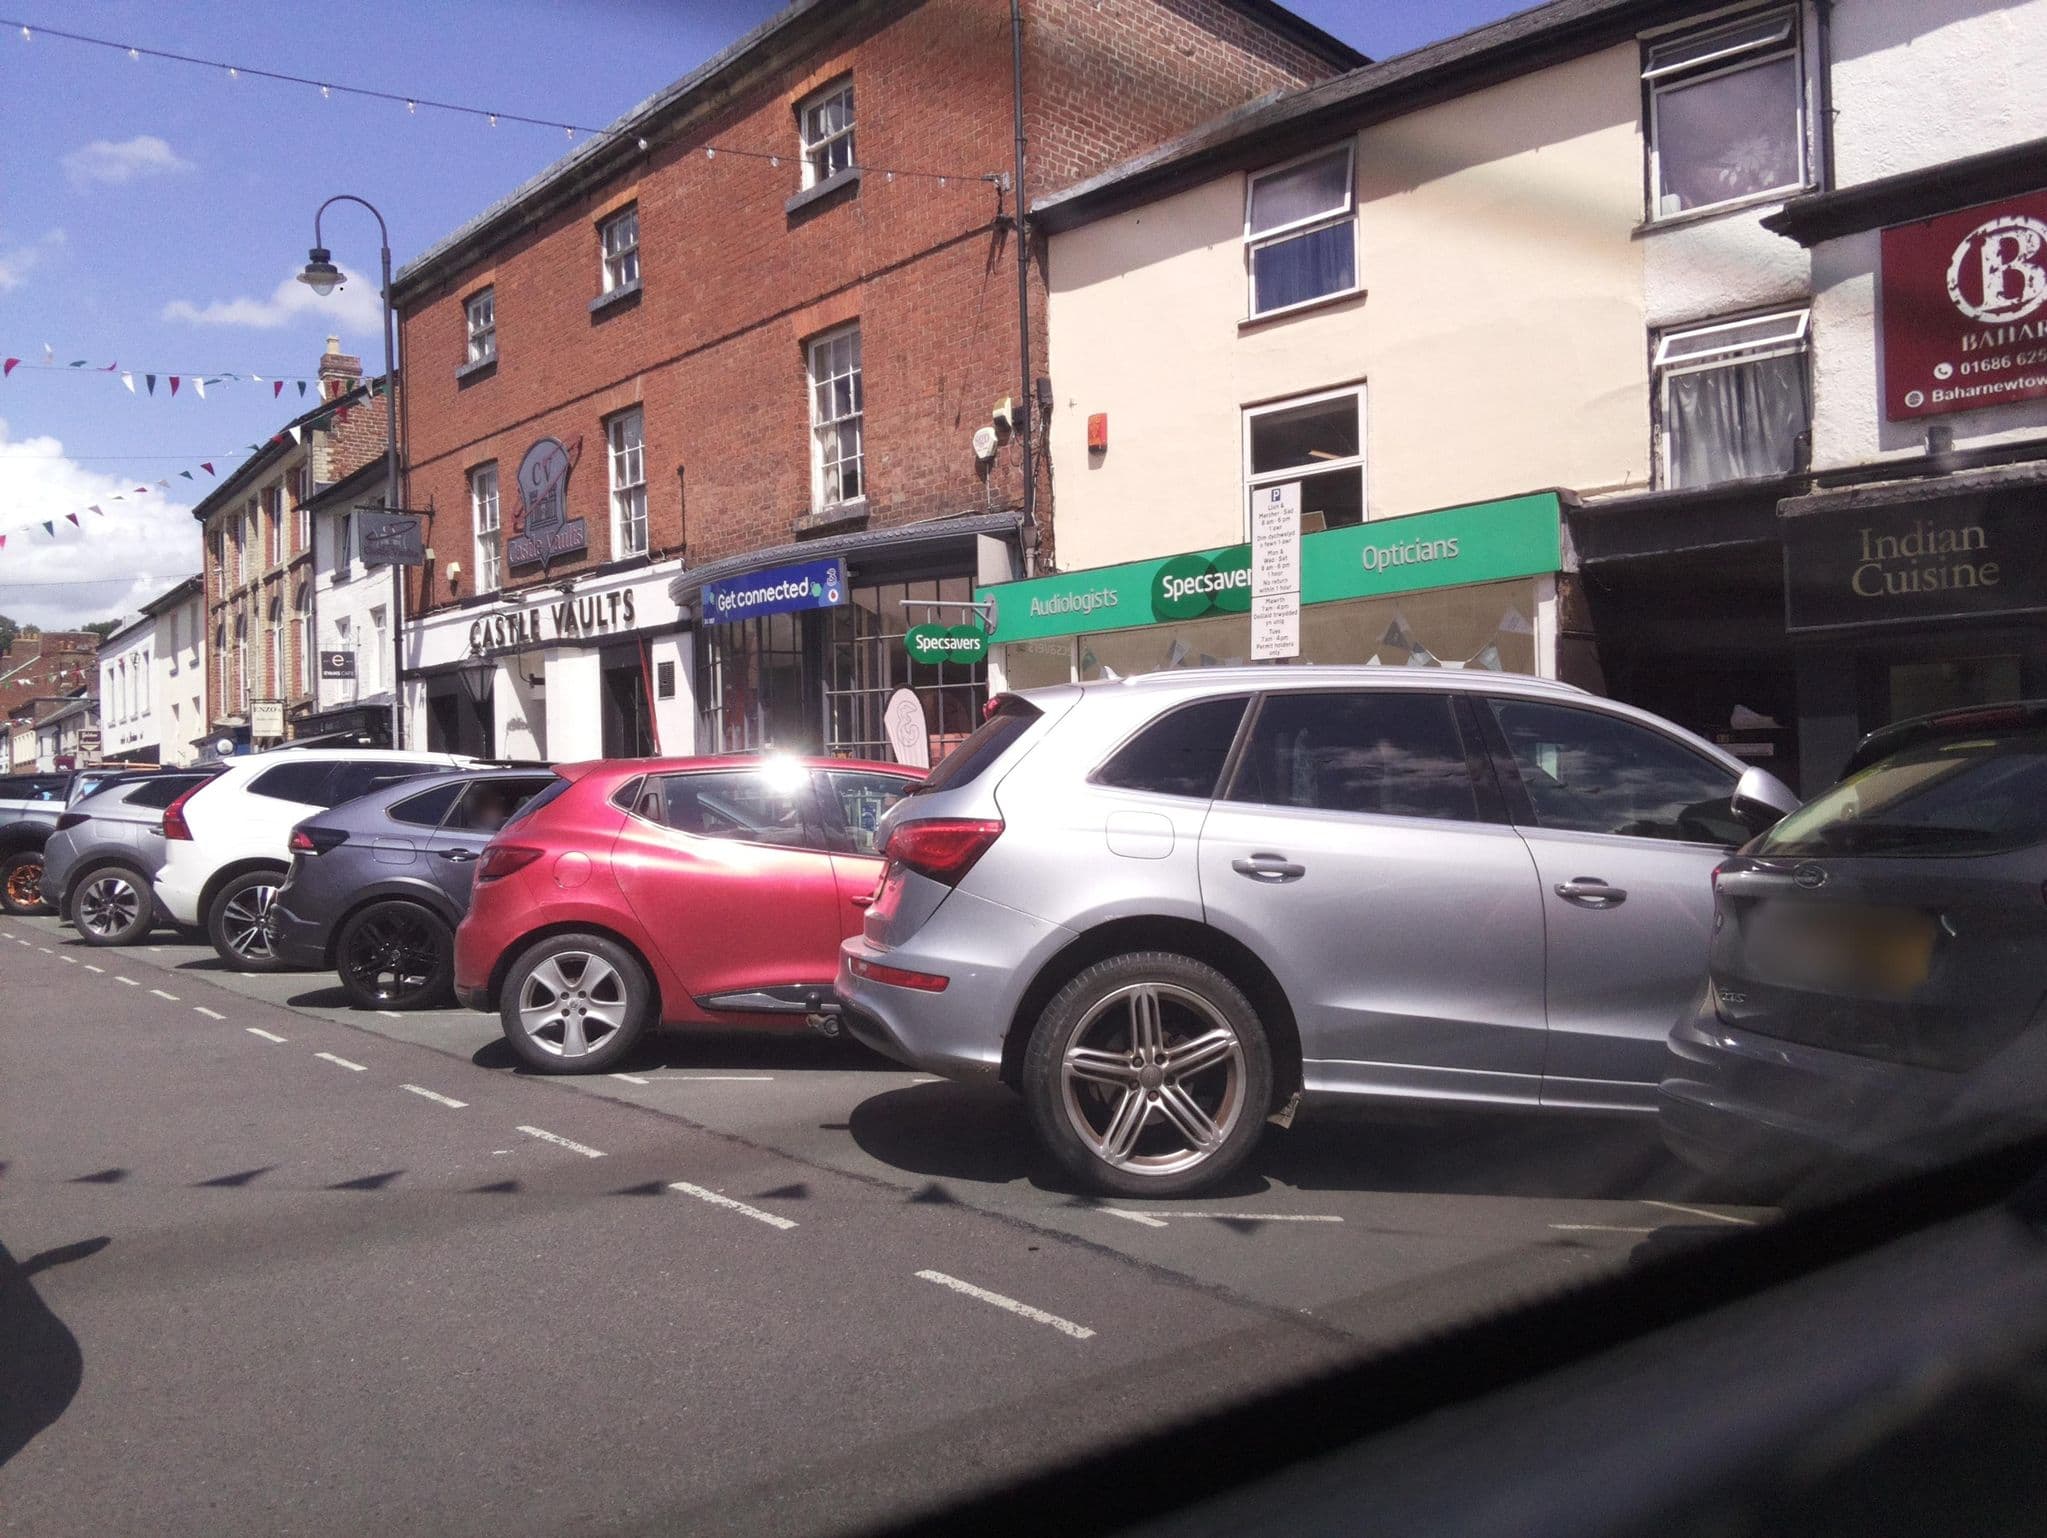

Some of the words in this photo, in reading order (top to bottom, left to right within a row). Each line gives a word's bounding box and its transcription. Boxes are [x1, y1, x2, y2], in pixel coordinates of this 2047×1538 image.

[1961, 355, 2011, 375] 01686
[1363, 537, 1459, 574] Opticians
[1859, 519, 1988, 561] Indian
[1162, 568, 1253, 601] Specsaver
[1852, 555, 2000, 597] Cuisine
[717, 591, 736, 611] Get
[737, 577, 809, 607] connected
[1030, 588, 1118, 617] Audiologists
[470, 609, 541, 649] CASTLE
[551, 588, 635, 639] VAULTS
[915, 634, 981, 653] Specsavers
